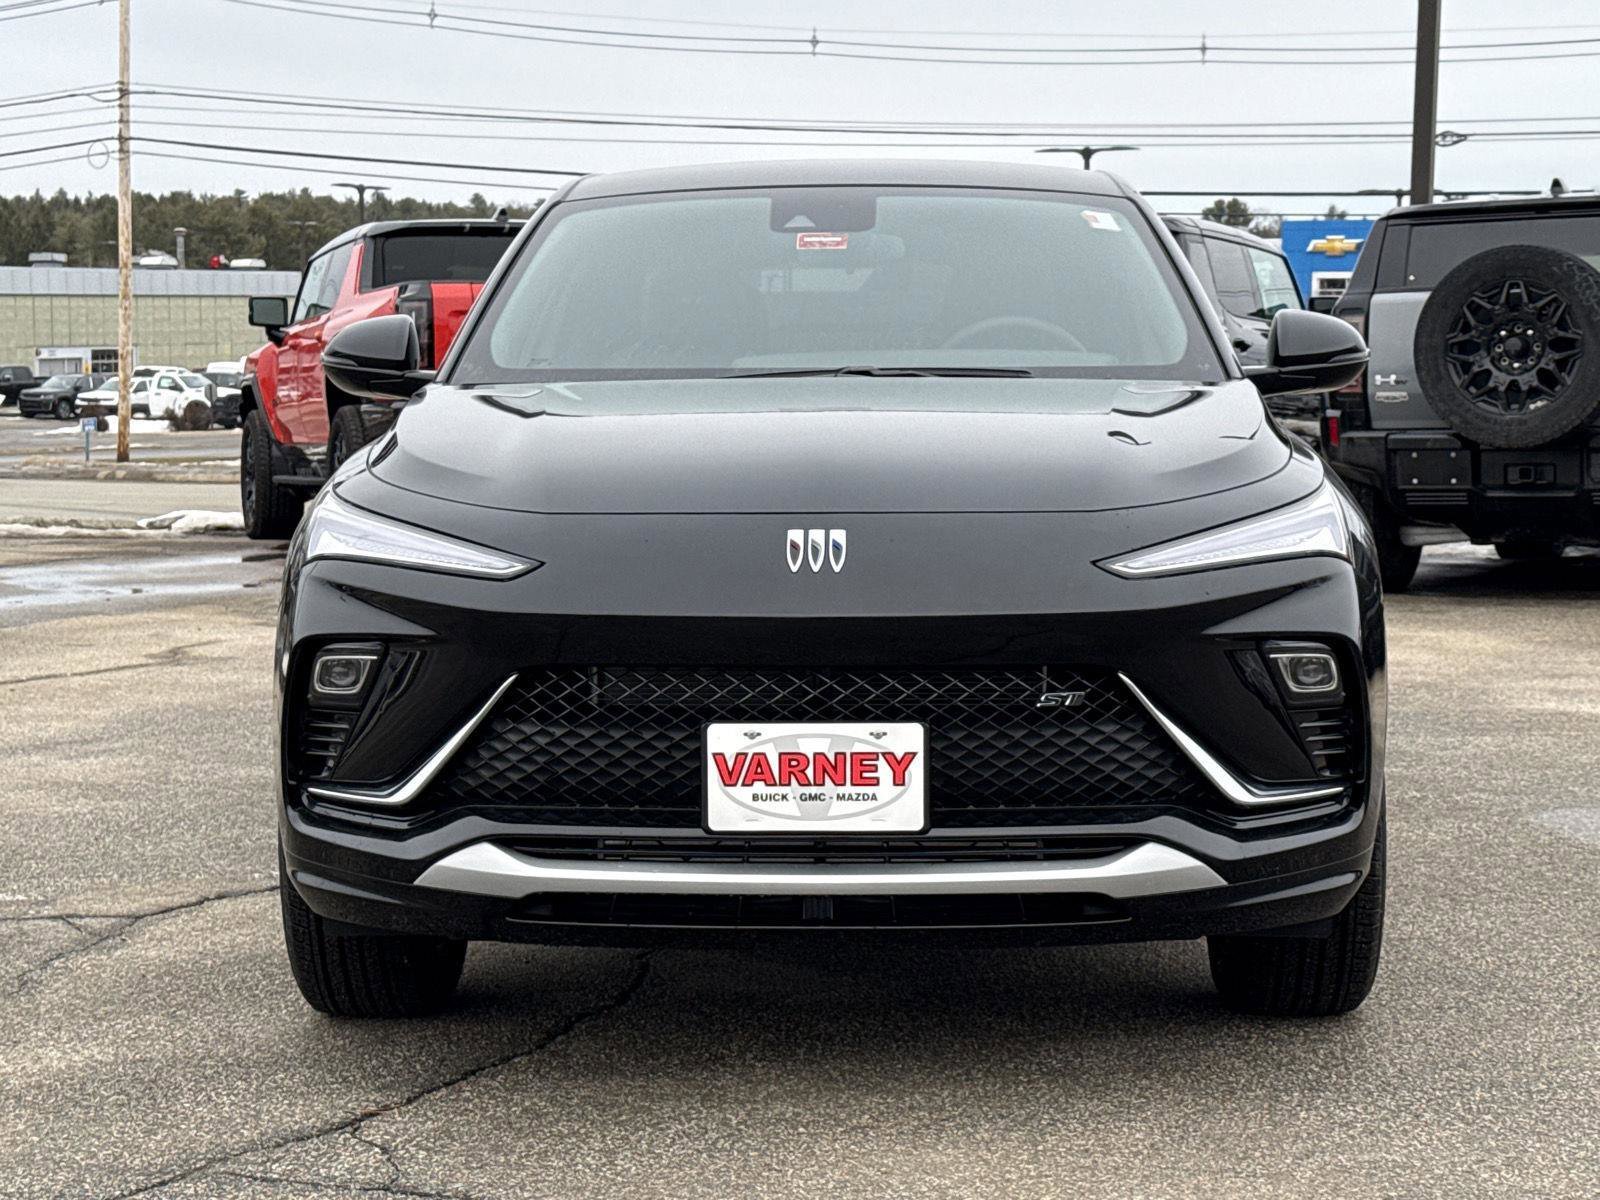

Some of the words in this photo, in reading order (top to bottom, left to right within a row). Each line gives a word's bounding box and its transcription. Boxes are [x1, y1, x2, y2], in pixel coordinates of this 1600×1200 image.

[1036, 691, 1085, 707] ST
[712, 751, 919, 787] VARNEY
[752, 792, 789, 802] BUICK
[799, 792, 826, 802] GMC
[836, 792, 878, 802] MAZDA
